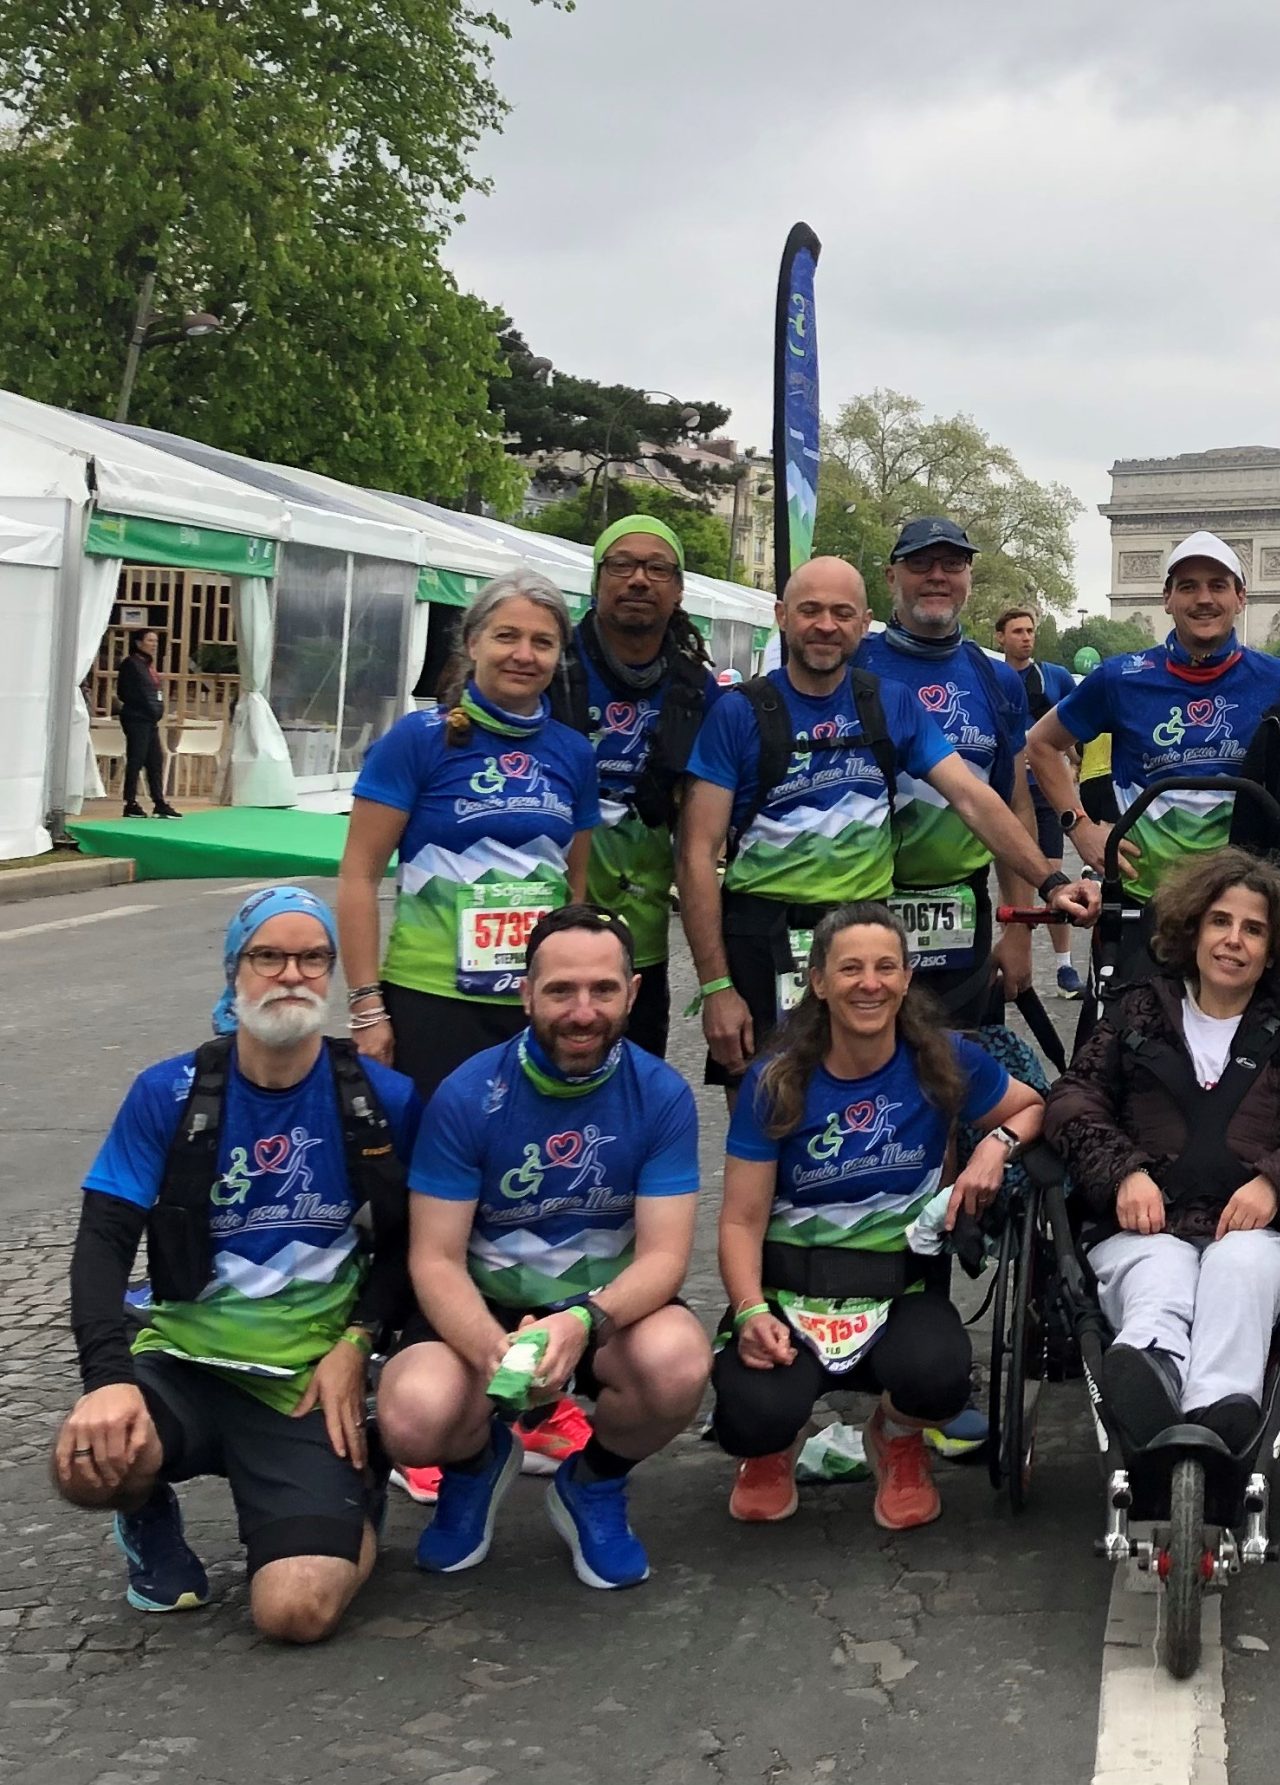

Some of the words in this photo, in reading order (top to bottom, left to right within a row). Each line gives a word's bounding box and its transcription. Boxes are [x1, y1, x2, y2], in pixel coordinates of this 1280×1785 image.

[960, 725, 998, 747] Mari
[812, 767, 844, 785] pour
[474, 911, 546, 949] 5735
[920, 954, 947, 967] asics
[585, 1186, 635, 1209] Mari
[244, 1204, 290, 1228] pour
[292, 1193, 351, 1220] Marie
